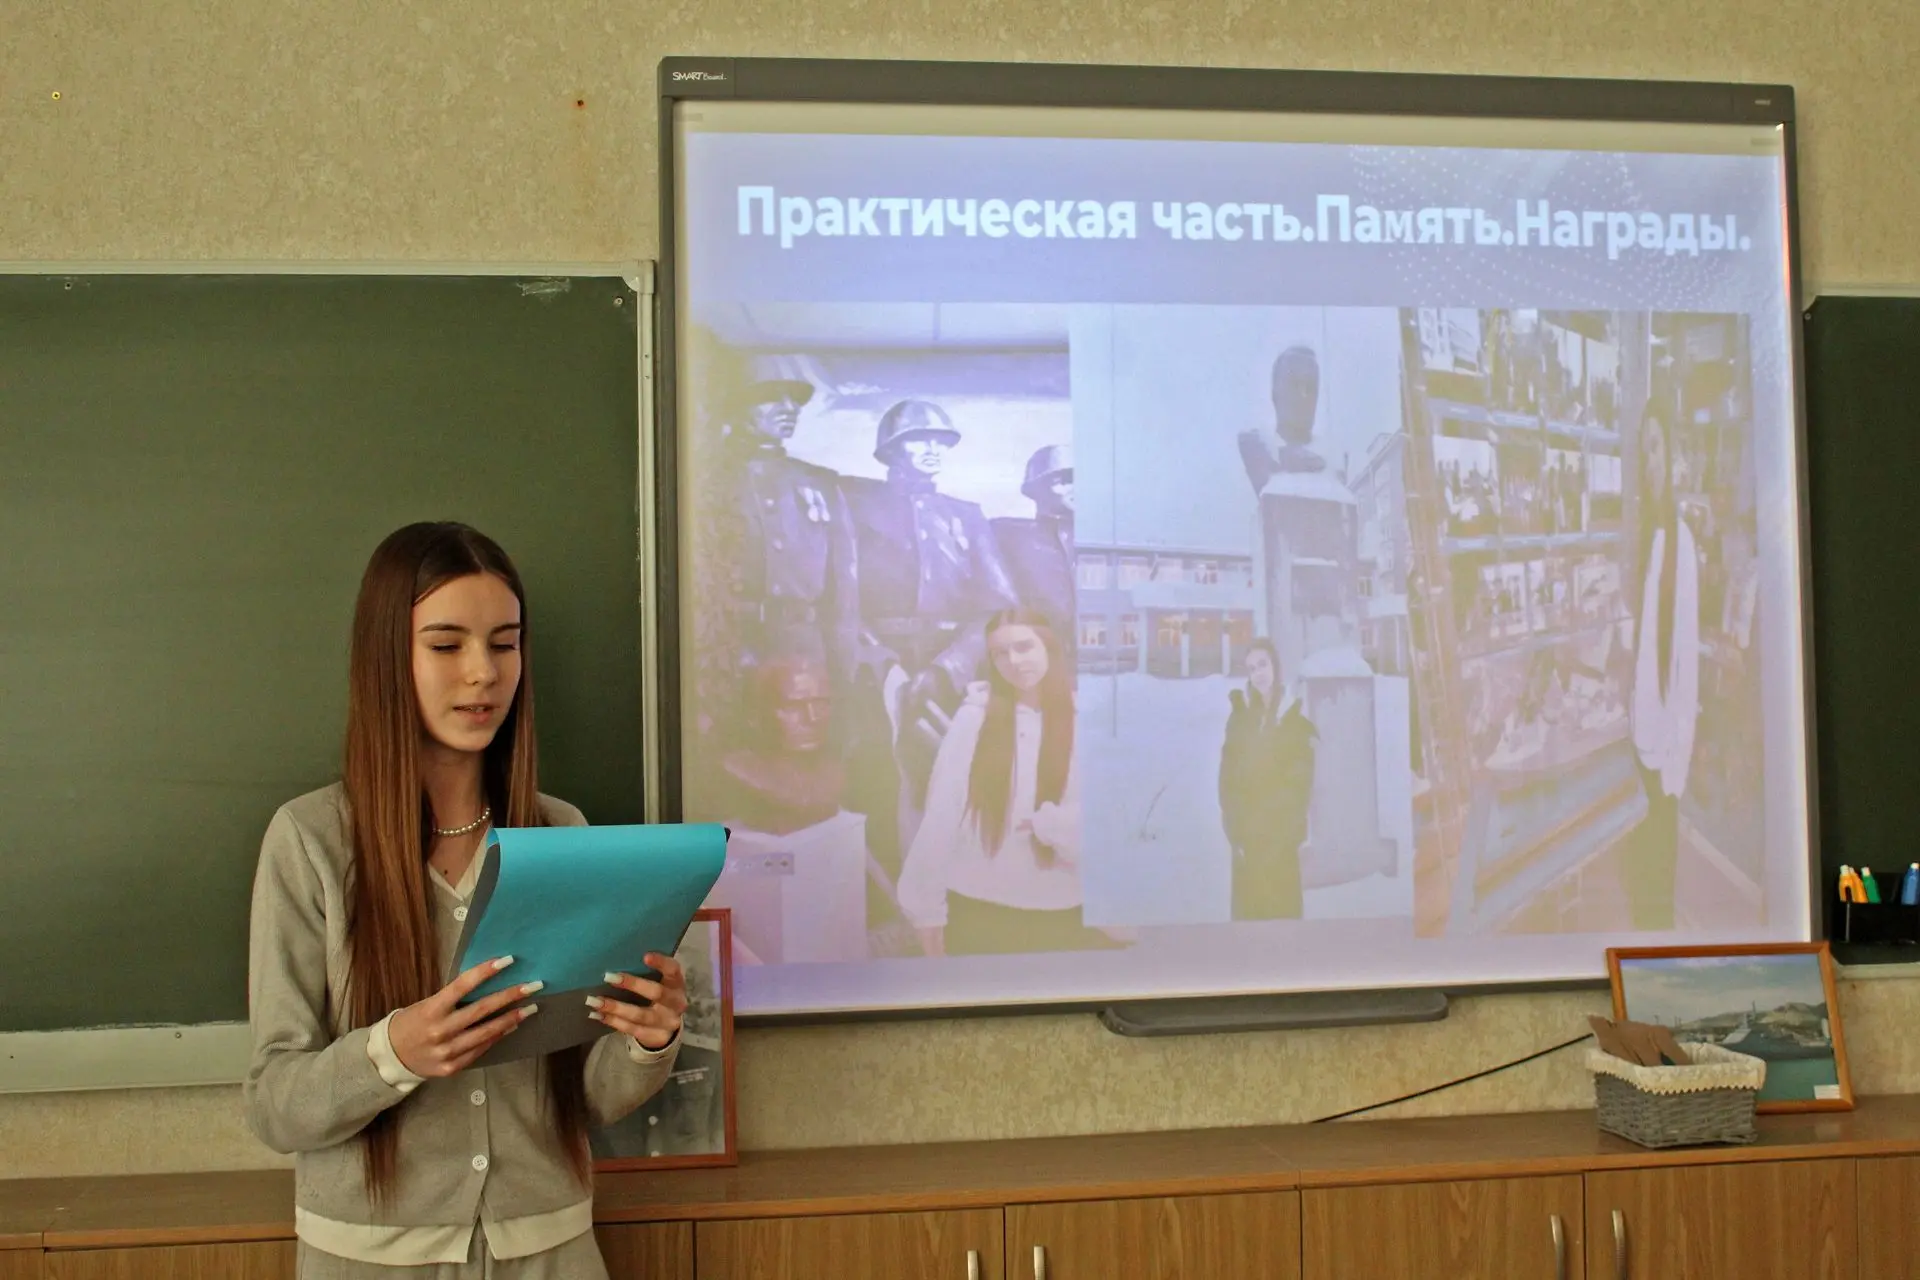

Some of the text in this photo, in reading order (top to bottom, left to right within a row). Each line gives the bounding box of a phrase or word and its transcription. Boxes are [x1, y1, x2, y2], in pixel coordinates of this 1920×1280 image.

[672, 71, 703, 81] SMART
[737, 185, 1752, 260] Практическая часть.Память.Награды.
